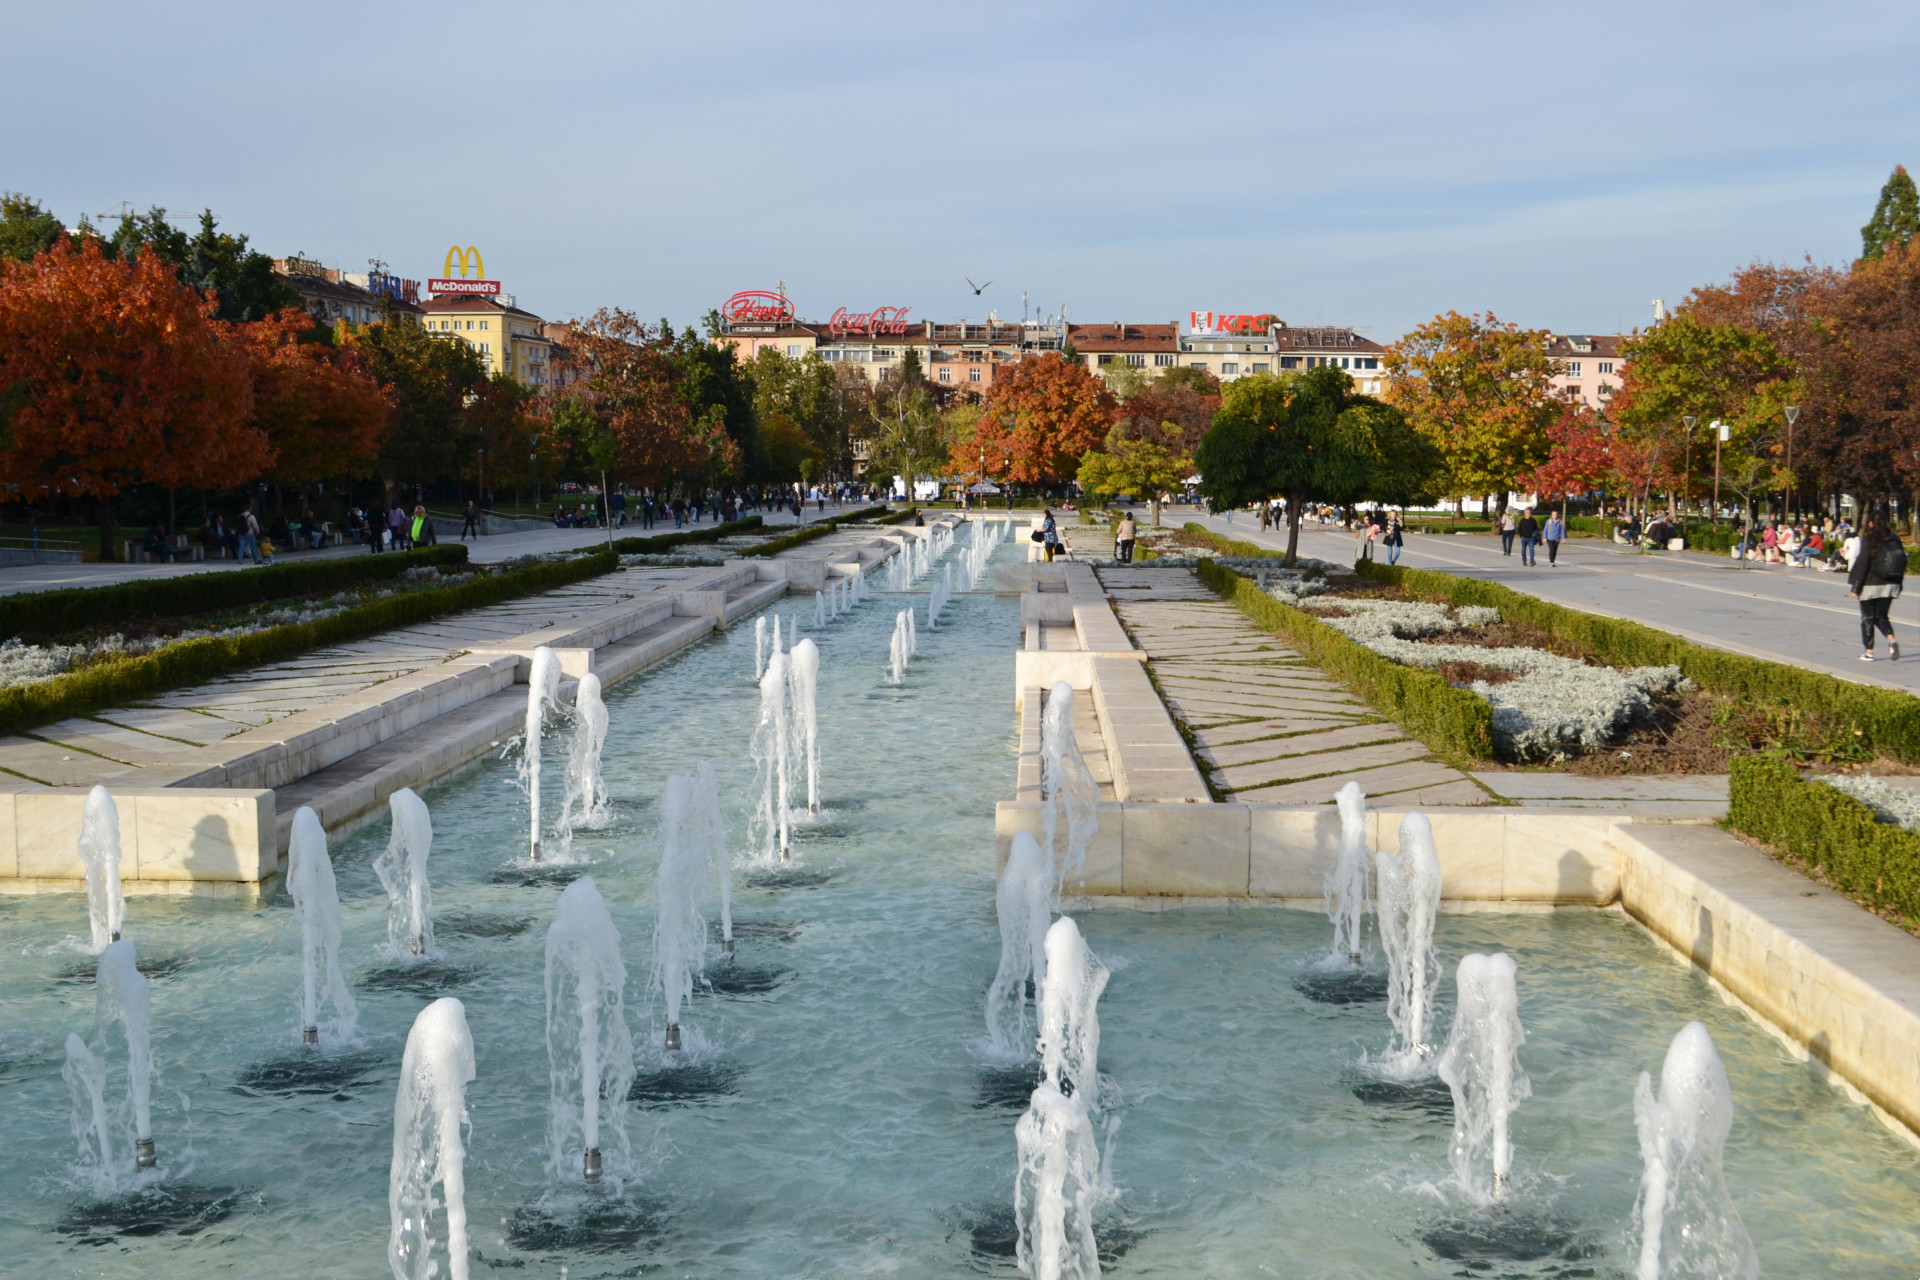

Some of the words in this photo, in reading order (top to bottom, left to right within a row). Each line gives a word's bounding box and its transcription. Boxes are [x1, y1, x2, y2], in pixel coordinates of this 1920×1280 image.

[431, 281, 496, 292] McDonald's
[731, 299, 786, 321] Happy
[1215, 314, 1267, 332] KFC
